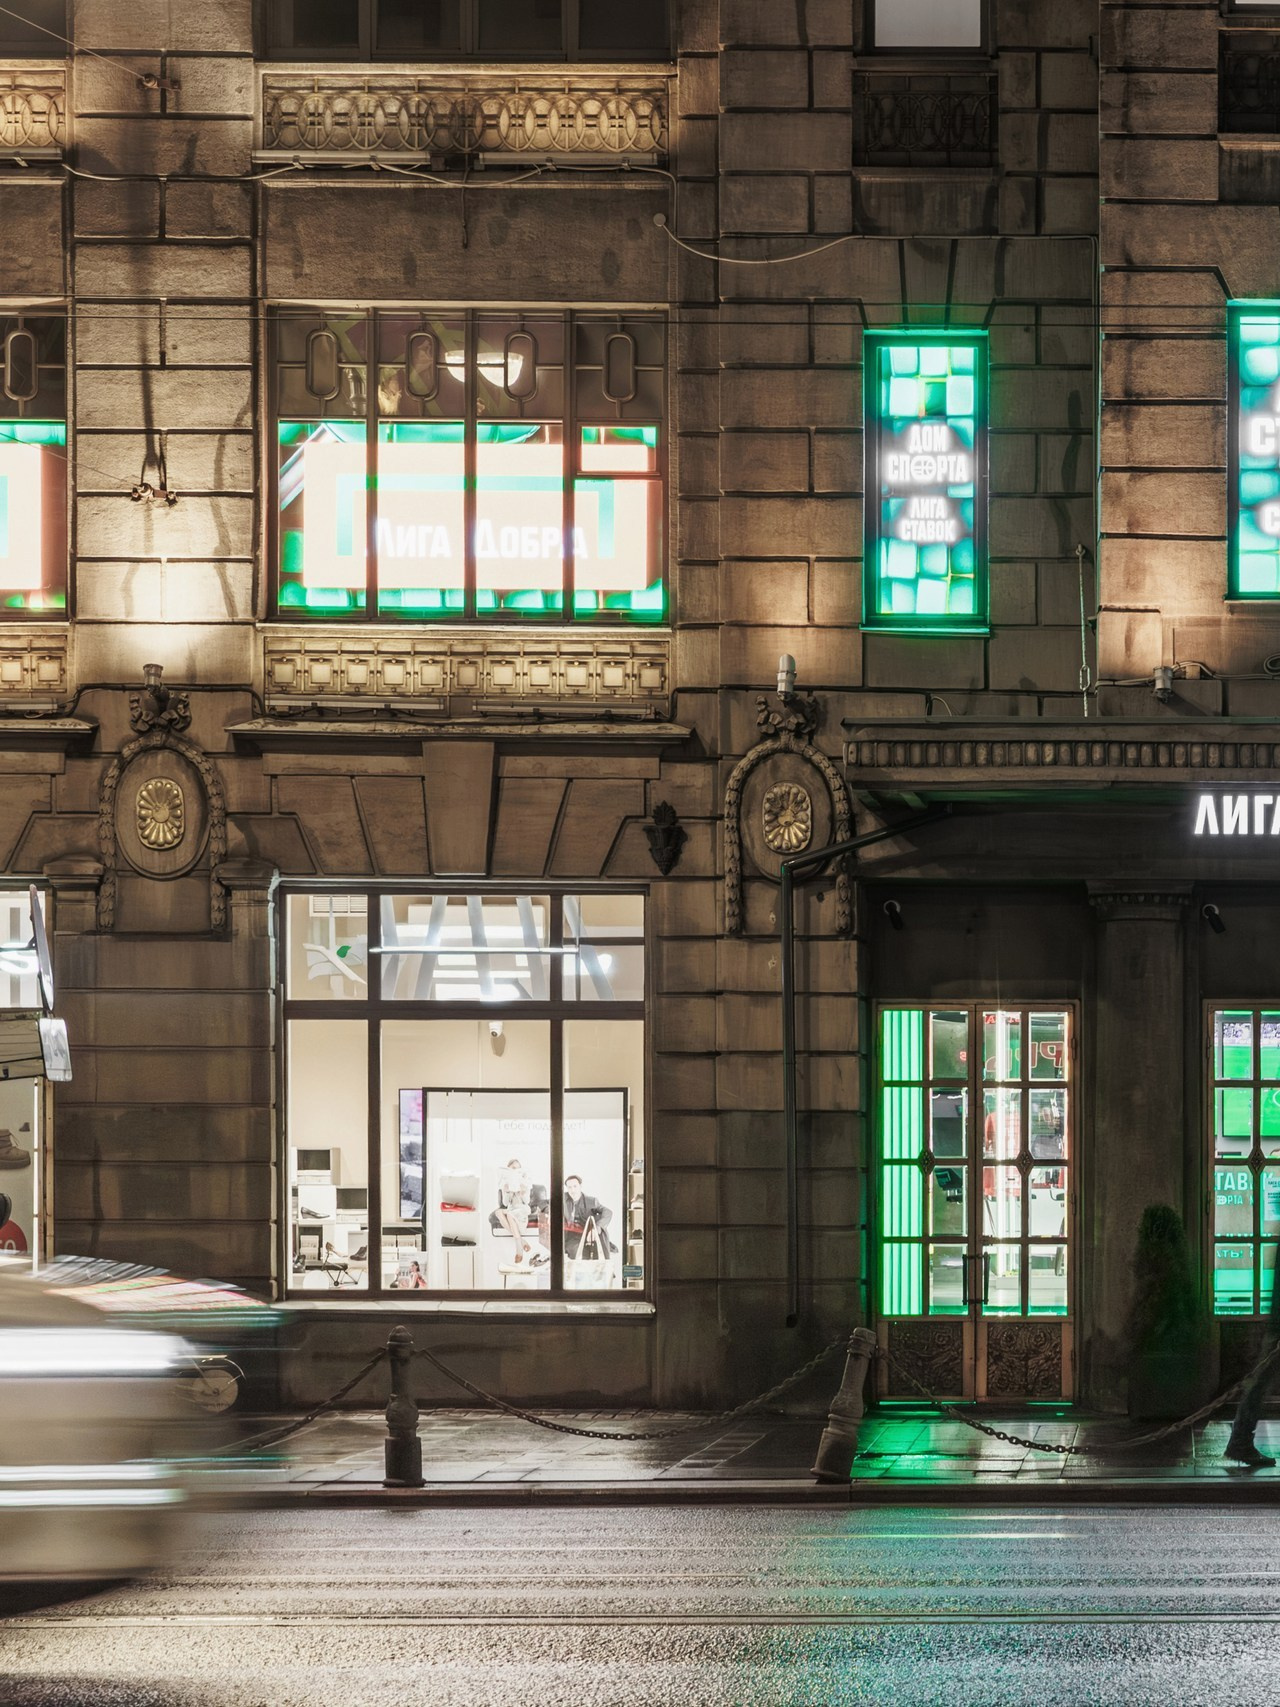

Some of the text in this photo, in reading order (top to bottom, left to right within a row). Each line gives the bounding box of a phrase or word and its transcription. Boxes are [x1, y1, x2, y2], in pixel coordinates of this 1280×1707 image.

[909, 424, 948, 453] ДОМ
[888, 454, 968, 482] СПОРТА
[910, 498, 947, 519] ЛИГА
[900, 519, 957, 541] СТАВОК
